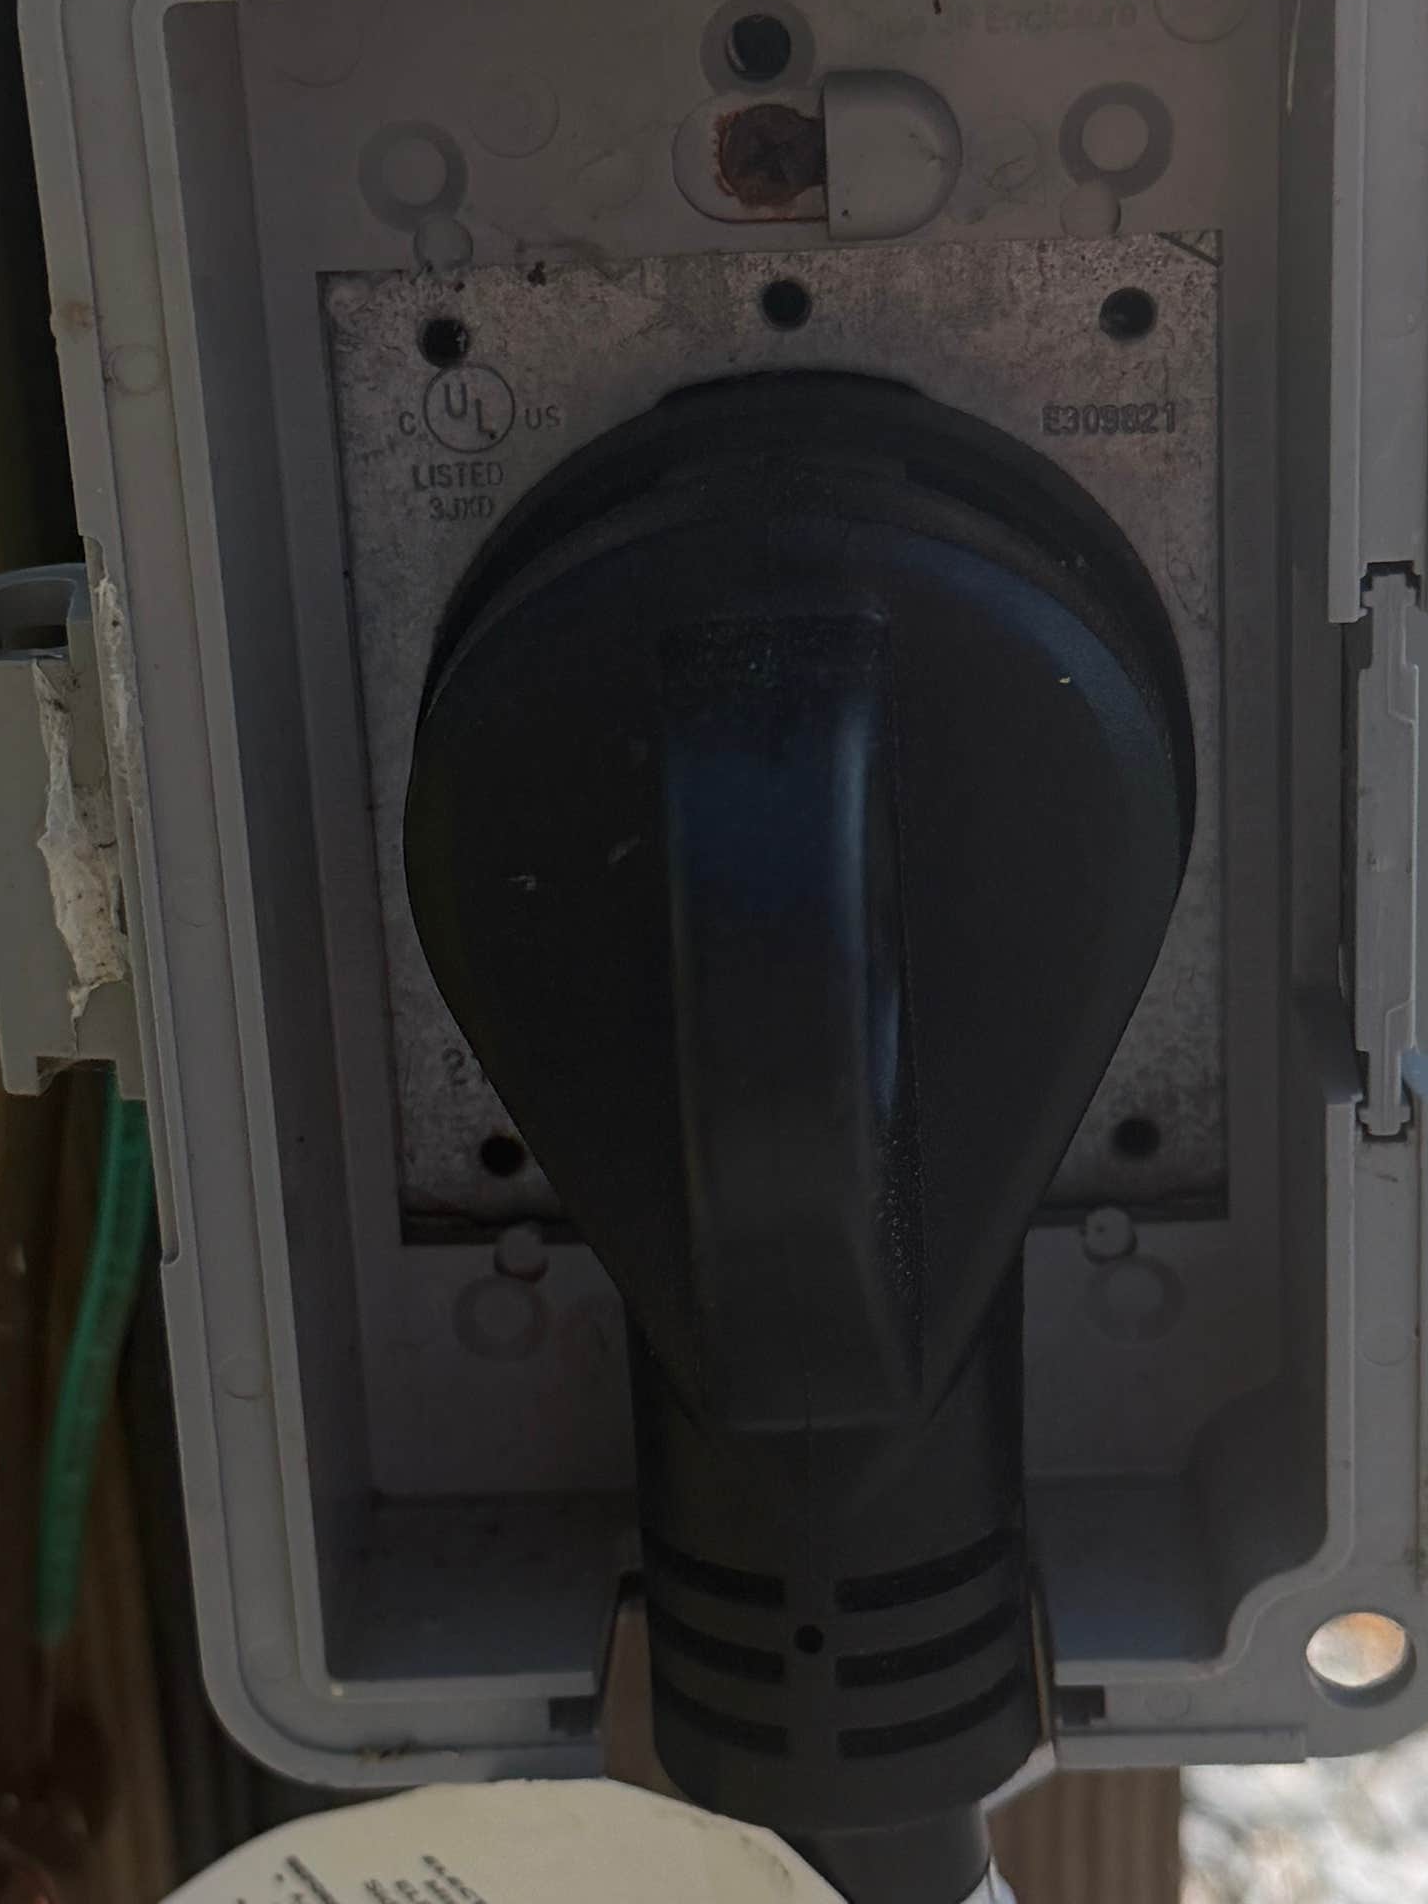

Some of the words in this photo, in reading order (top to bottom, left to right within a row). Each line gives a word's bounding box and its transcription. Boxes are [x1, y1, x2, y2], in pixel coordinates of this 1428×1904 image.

[444, 381, 498, 441] UL
[524, 404, 561, 431] US
[411, 460, 505, 491] LISTED
